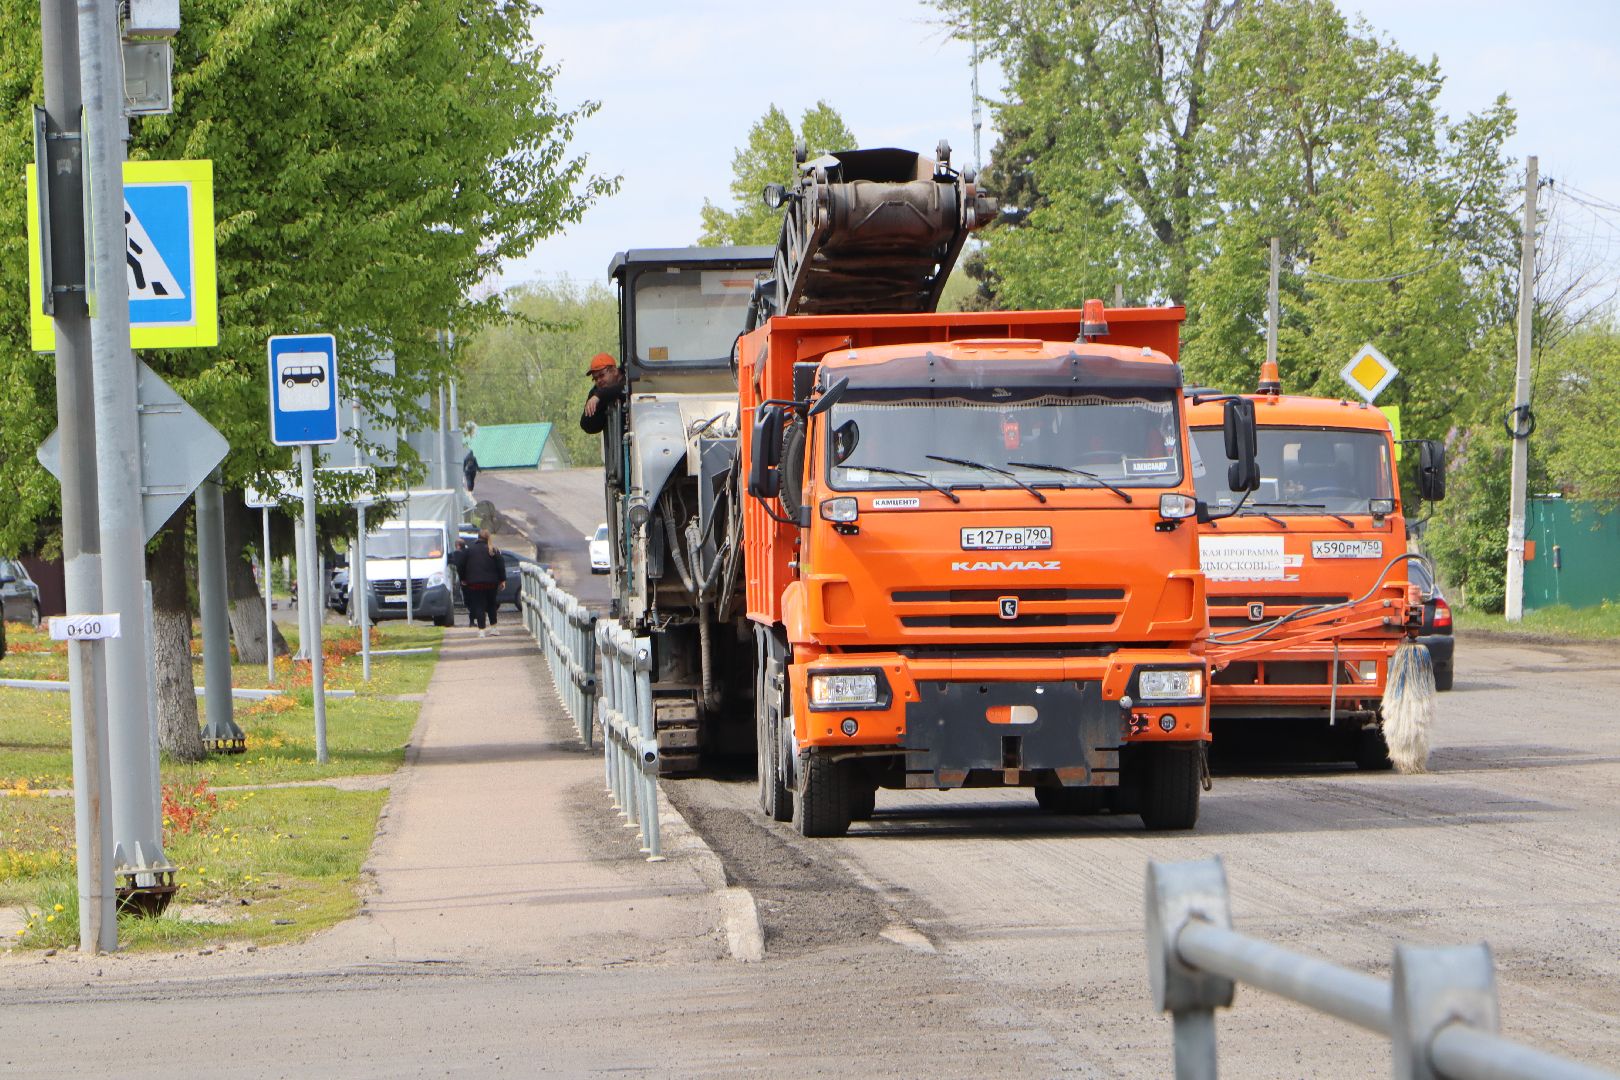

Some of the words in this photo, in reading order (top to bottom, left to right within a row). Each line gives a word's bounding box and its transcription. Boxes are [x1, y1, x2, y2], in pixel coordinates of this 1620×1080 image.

[1025, 528, 1047, 540] 790
[1362, 541, 1379, 551] 750
[1200, 549, 1221, 557] КАЯ
[1224, 548, 1279, 557] ПРОГРАММА
[951, 560, 1061, 571] KAMAZ
[67, 622, 101, 636] 0+00
